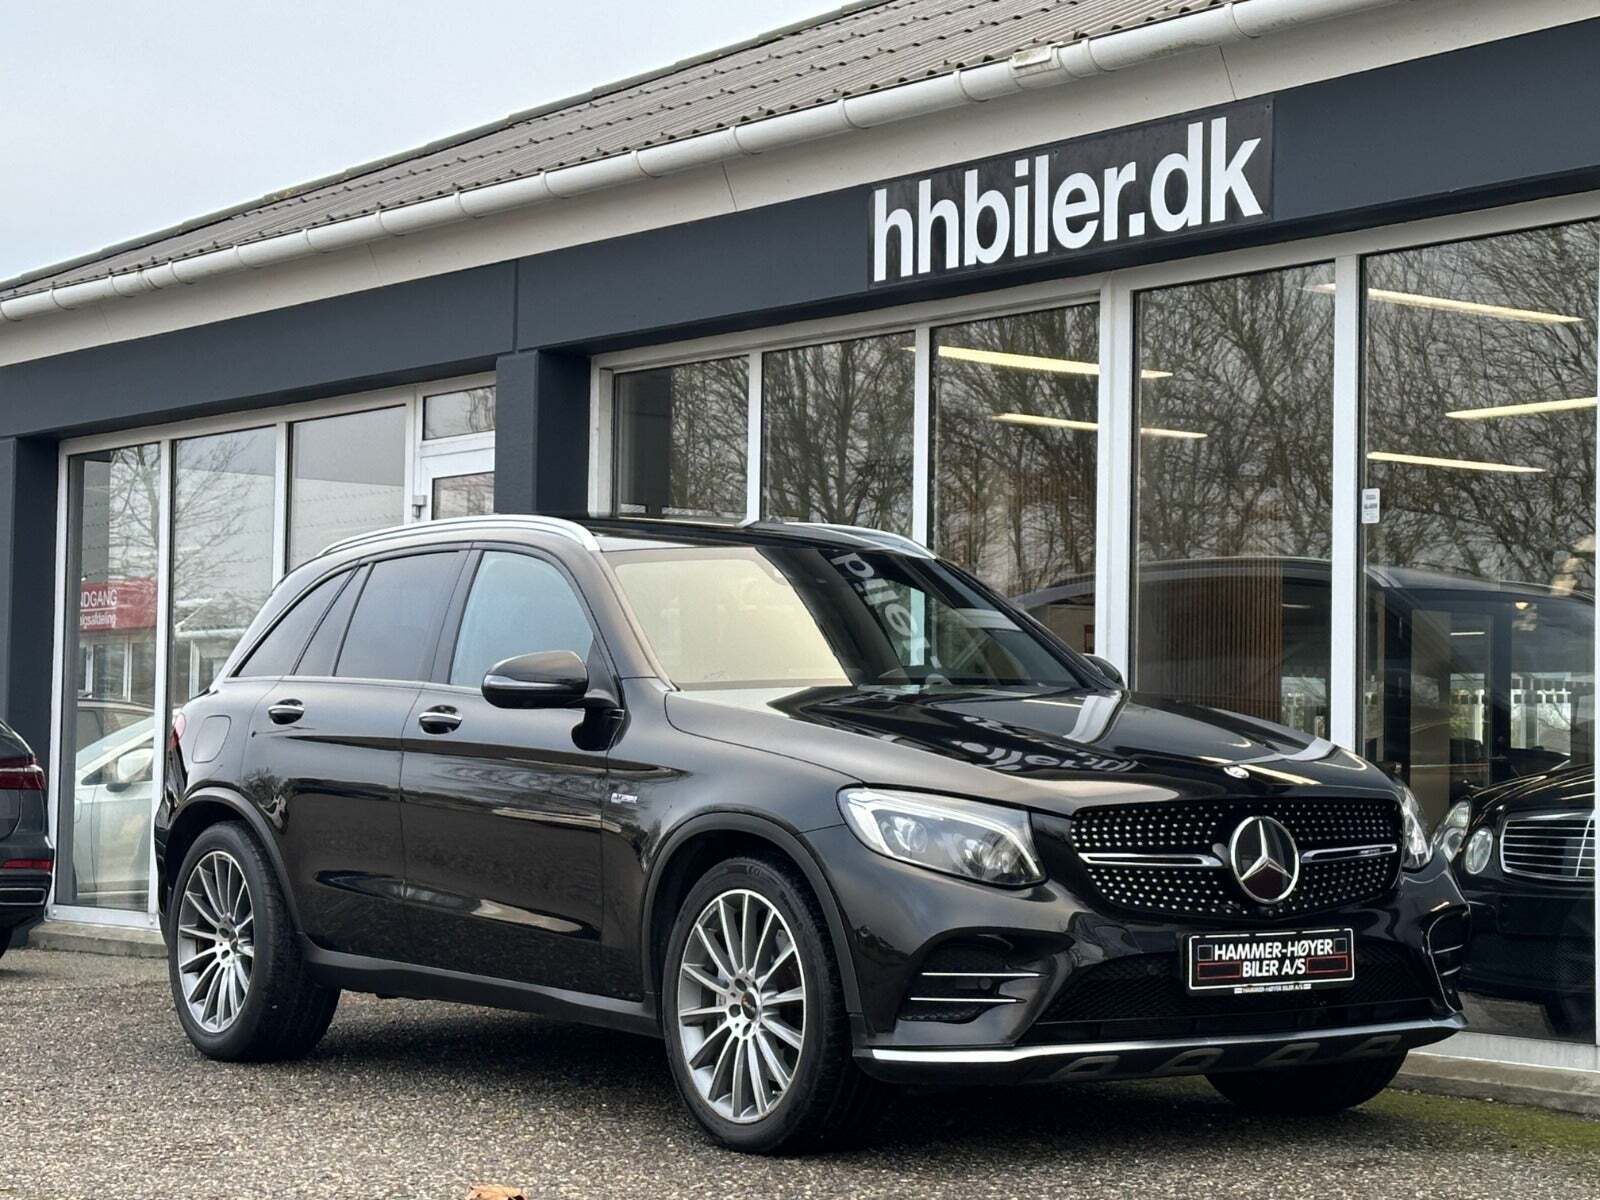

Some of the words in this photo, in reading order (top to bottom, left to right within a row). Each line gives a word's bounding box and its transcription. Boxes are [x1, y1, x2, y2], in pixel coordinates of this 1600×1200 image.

[874, 117, 1263, 282] hhbiler.dk
[1214, 939, 1333, 960] HAMMER-HØYER
[1242, 959, 1278, 977] BILER
[1281, 958, 1306, 975] A/S
